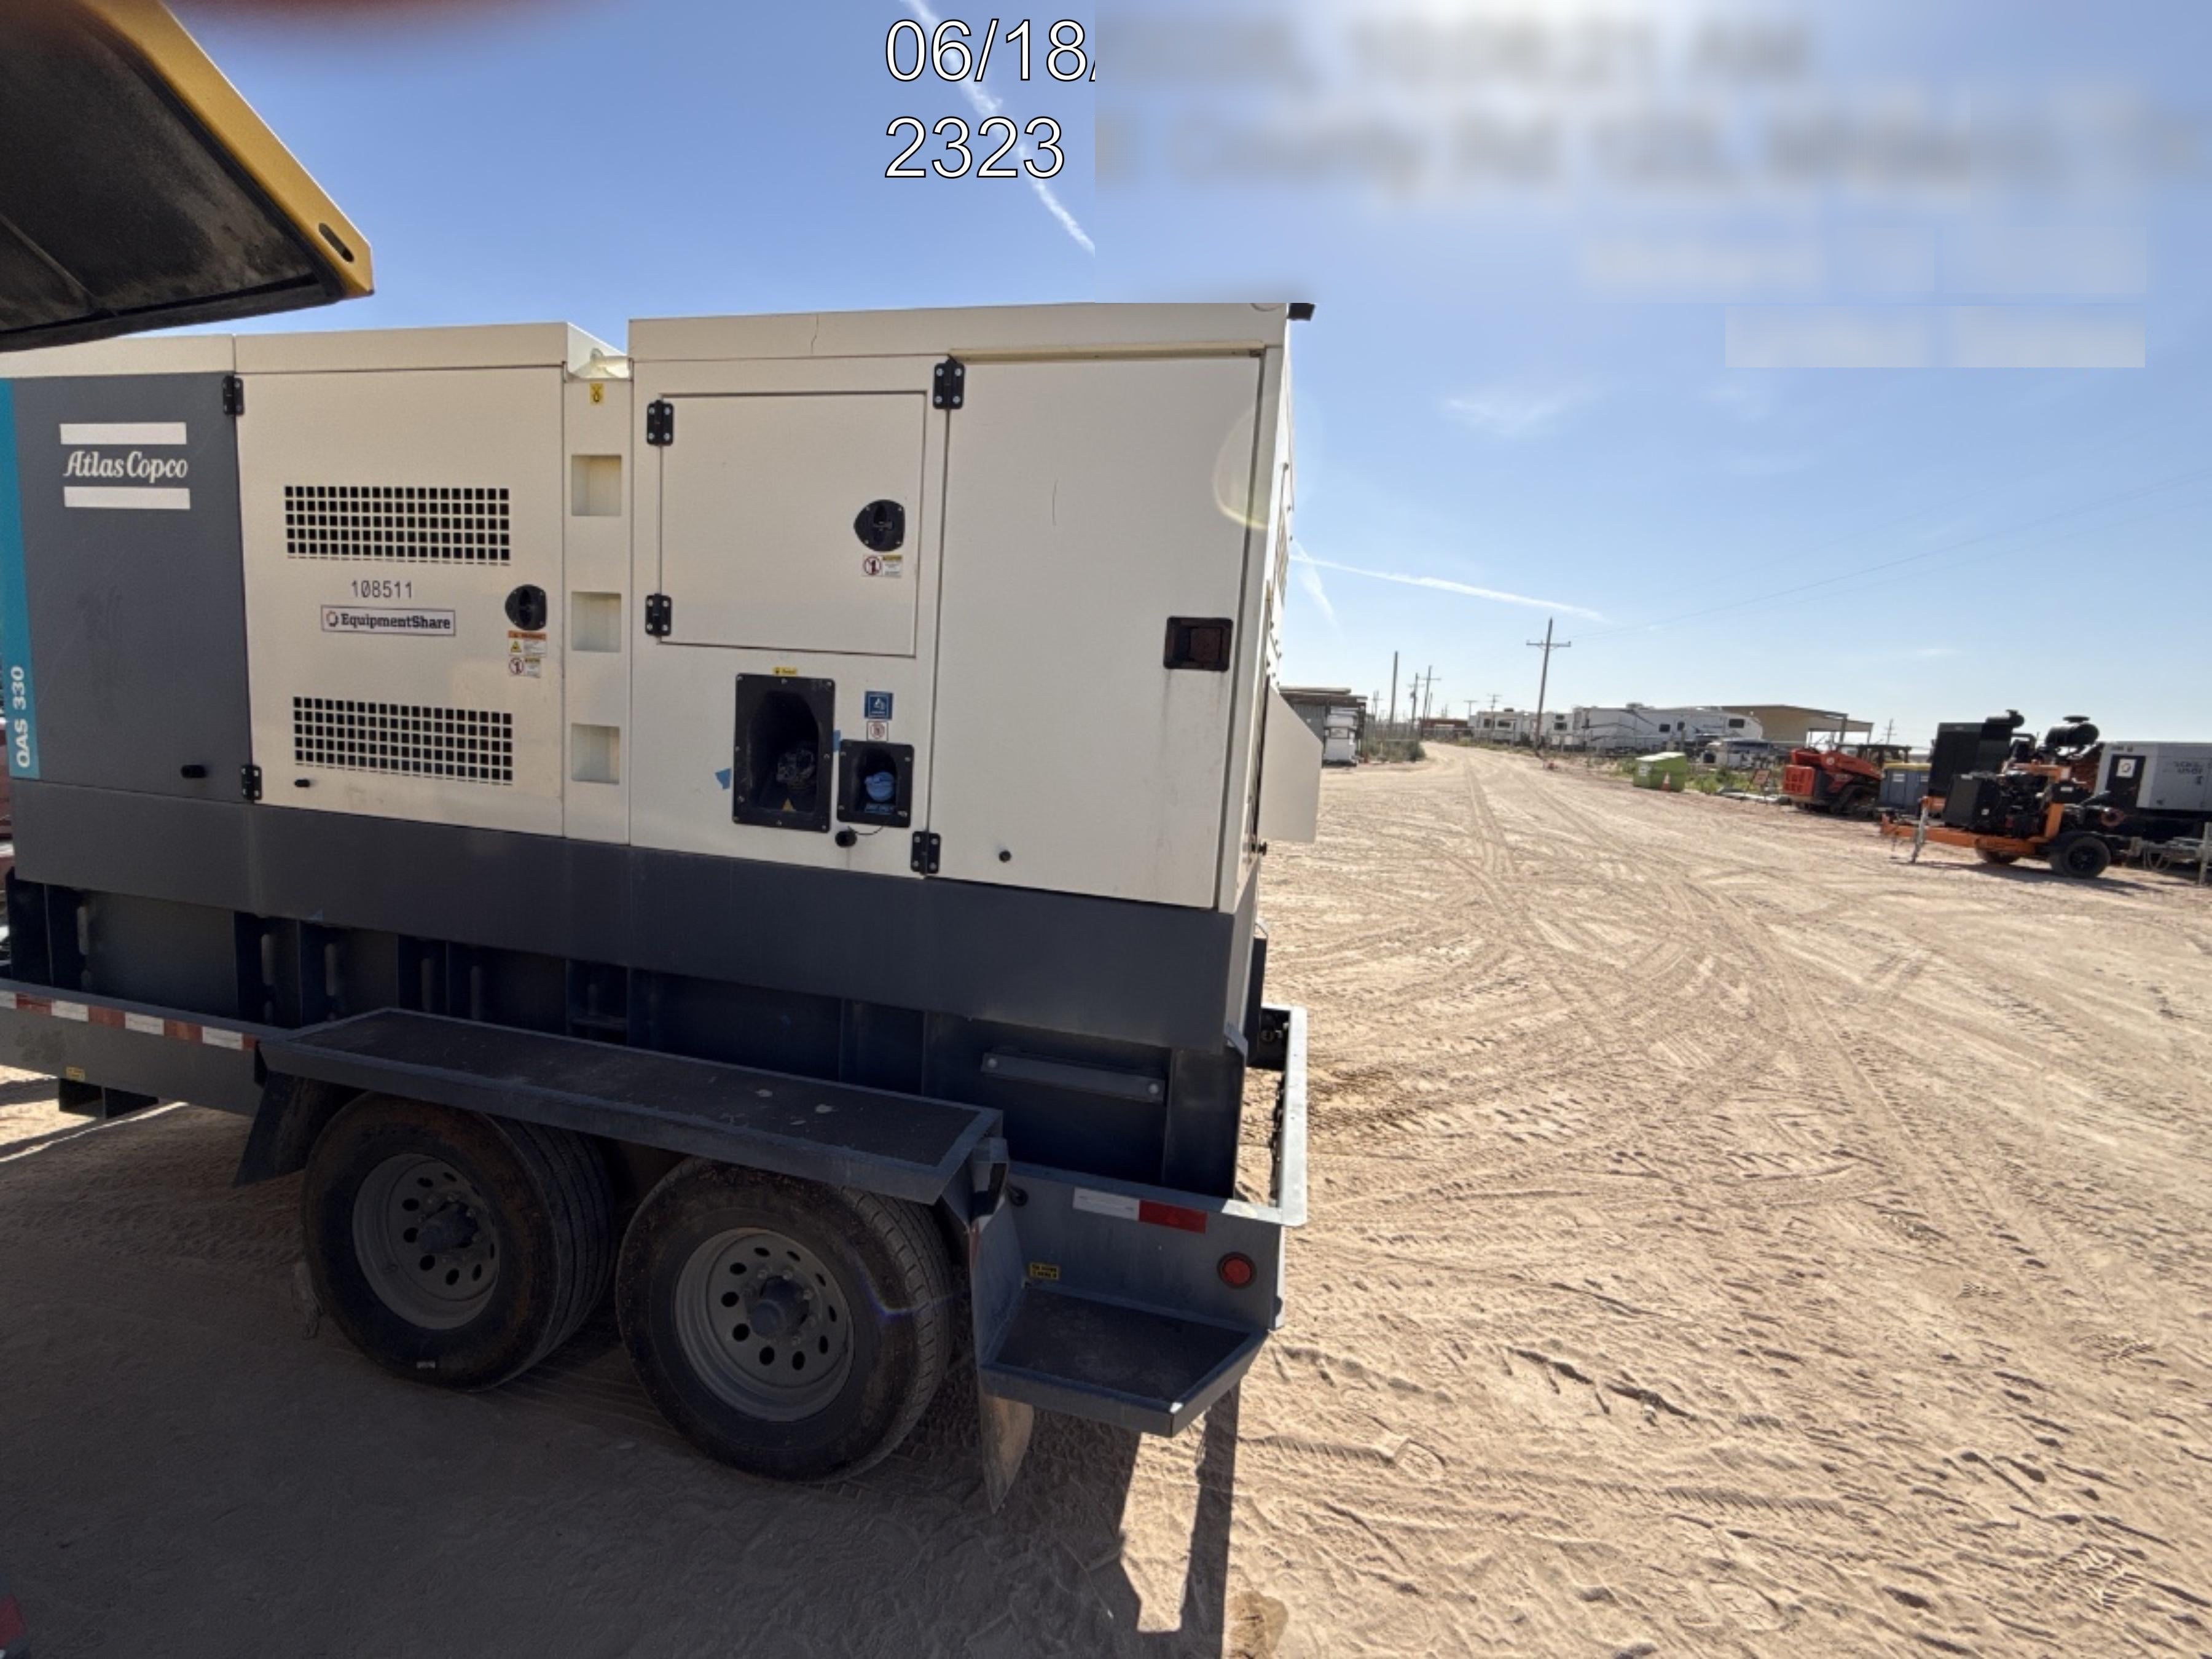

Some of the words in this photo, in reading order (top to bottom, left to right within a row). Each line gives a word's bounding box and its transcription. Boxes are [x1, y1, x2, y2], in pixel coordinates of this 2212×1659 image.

[63, 450, 124, 477] Atlas
[127, 450, 187, 484] Copco
[351, 579, 413, 600] 108511
[340, 613, 450, 629] EquipmentShare
[10, 665, 26, 710] 330
[14, 718, 30, 767] QAS
